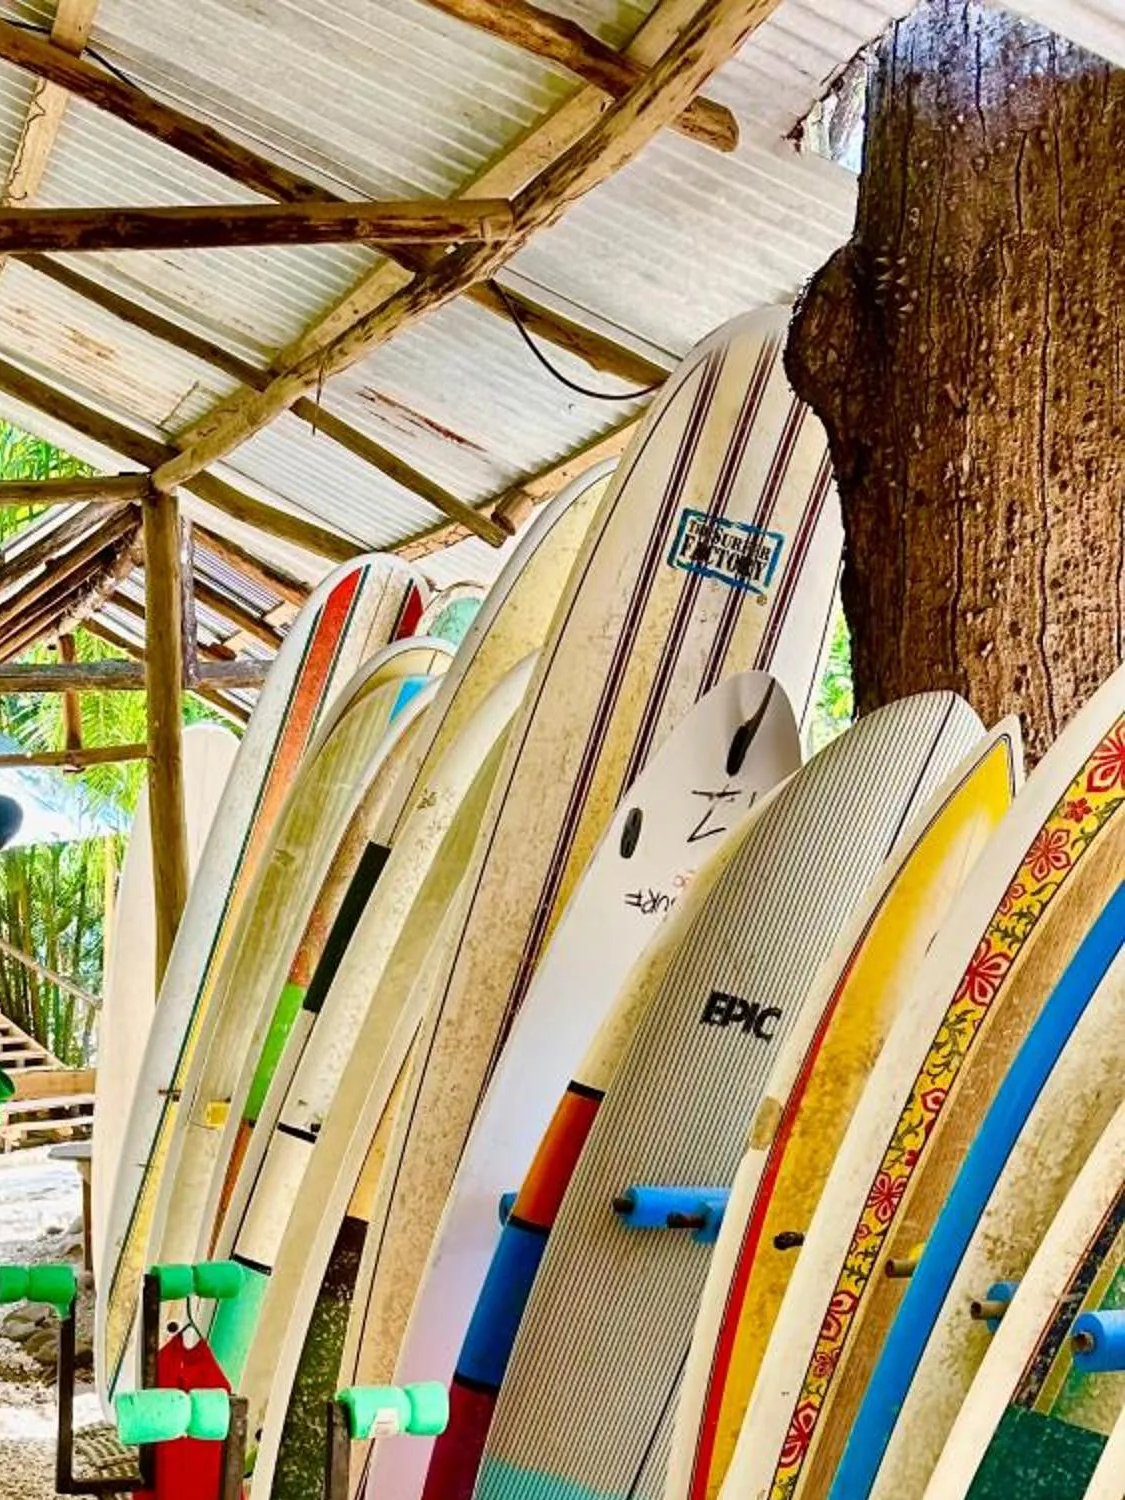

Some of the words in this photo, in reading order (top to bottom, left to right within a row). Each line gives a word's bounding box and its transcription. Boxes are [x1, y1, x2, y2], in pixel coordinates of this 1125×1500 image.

[679, 533, 768, 580] FACTORY
[625, 886, 676, 915] URF
[700, 989, 783, 1043] EPIC
